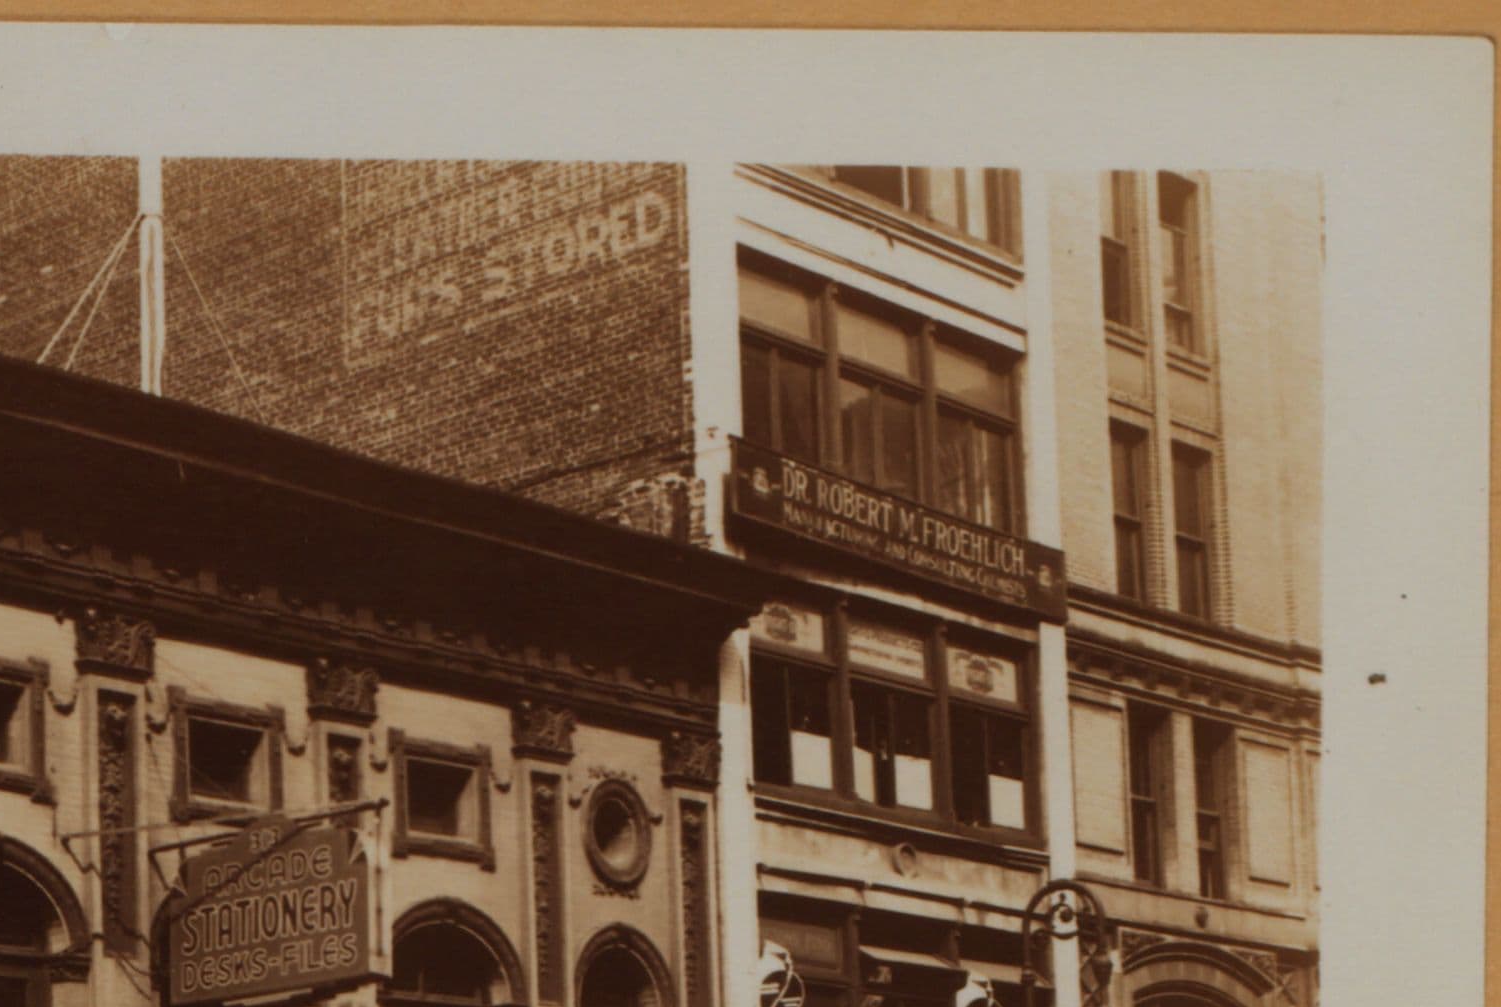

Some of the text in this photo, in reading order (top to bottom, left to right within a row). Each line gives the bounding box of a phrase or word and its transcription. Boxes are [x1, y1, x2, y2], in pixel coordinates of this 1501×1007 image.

[482, 192, 672, 303] STORED
[781, 465, 811, 503] DR.
[817, 477, 893, 534] ROBERT
[922, 517, 1026, 577] FROEHLICH
[203, 845, 333, 898] ARCADE
[180, 878, 357, 956] STATIONERY
[180, 933, 358, 993] DESKS-FILES
